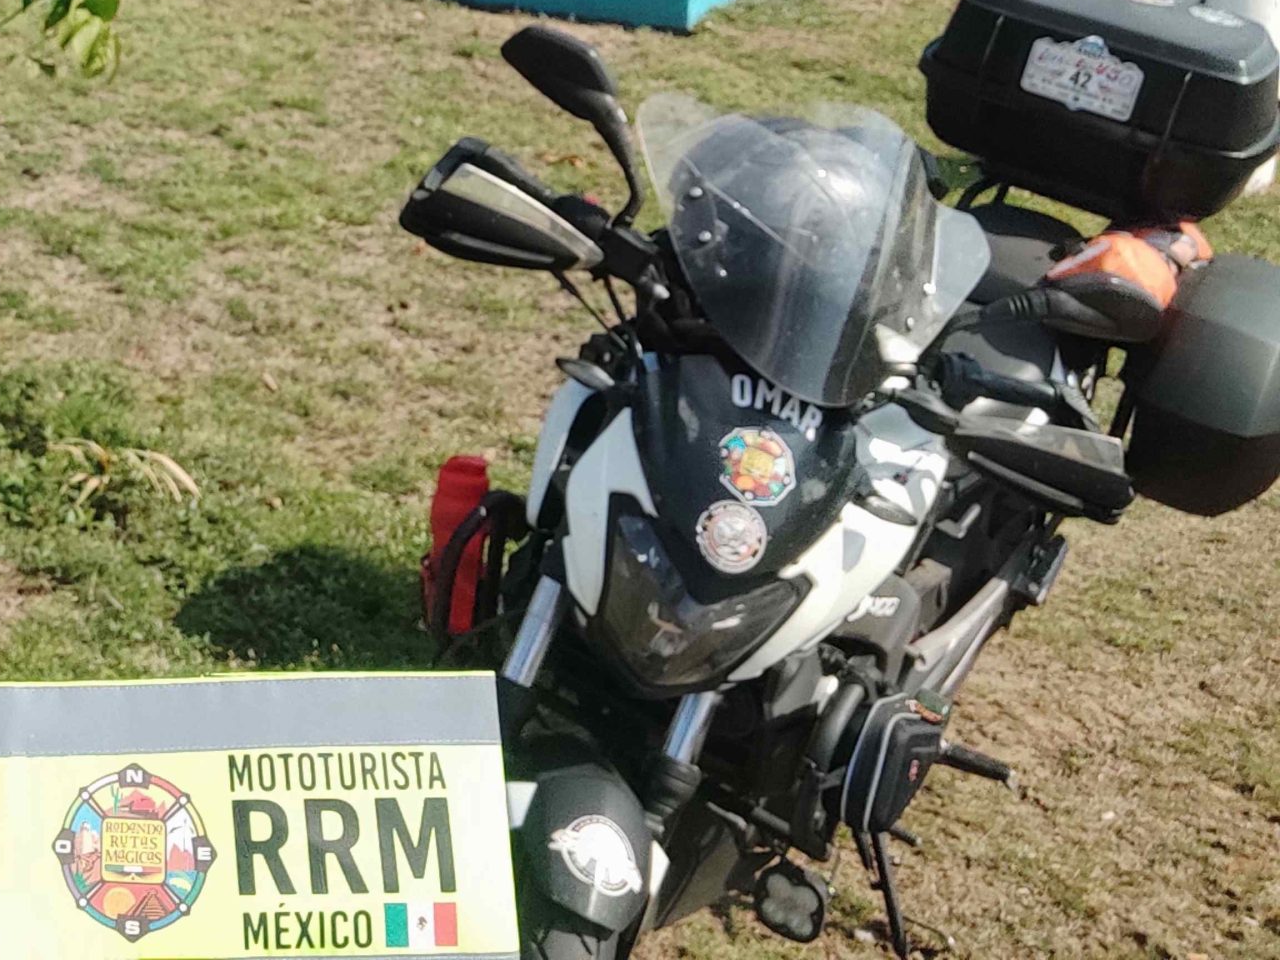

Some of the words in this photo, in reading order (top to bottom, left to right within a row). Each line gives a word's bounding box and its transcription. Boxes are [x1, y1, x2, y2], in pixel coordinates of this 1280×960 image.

[731, 373, 823, 435] OMAR
[125, 769, 144, 784] N
[228, 751, 446, 792] MOTOTURISTA
[196, 846, 213, 861] E
[232, 797, 457, 895] RRM
[124, 920, 141, 936] S
[243, 902, 373, 951] MÉXICO
